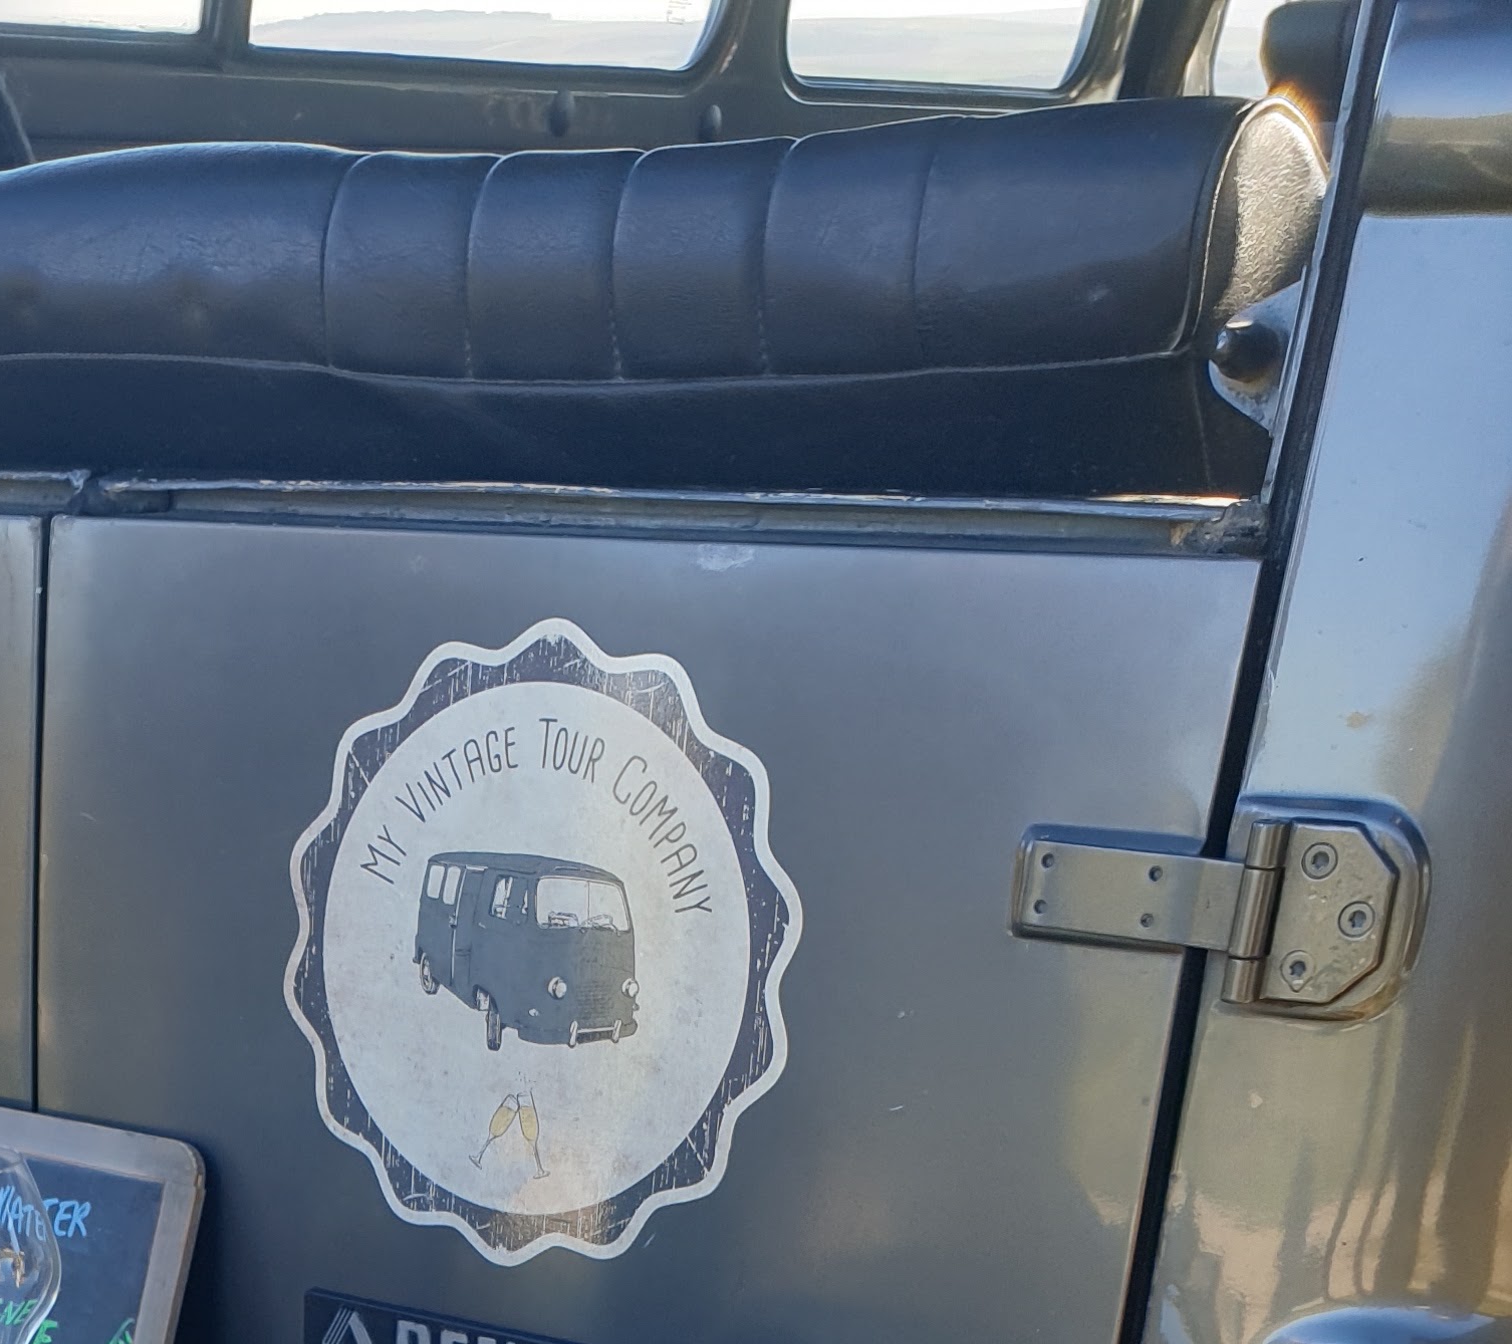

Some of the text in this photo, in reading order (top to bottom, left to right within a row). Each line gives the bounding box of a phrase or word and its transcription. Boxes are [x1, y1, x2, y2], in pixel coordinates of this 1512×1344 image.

[360, 717, 713, 915] MY VINTAGE TOUR COMPANY
